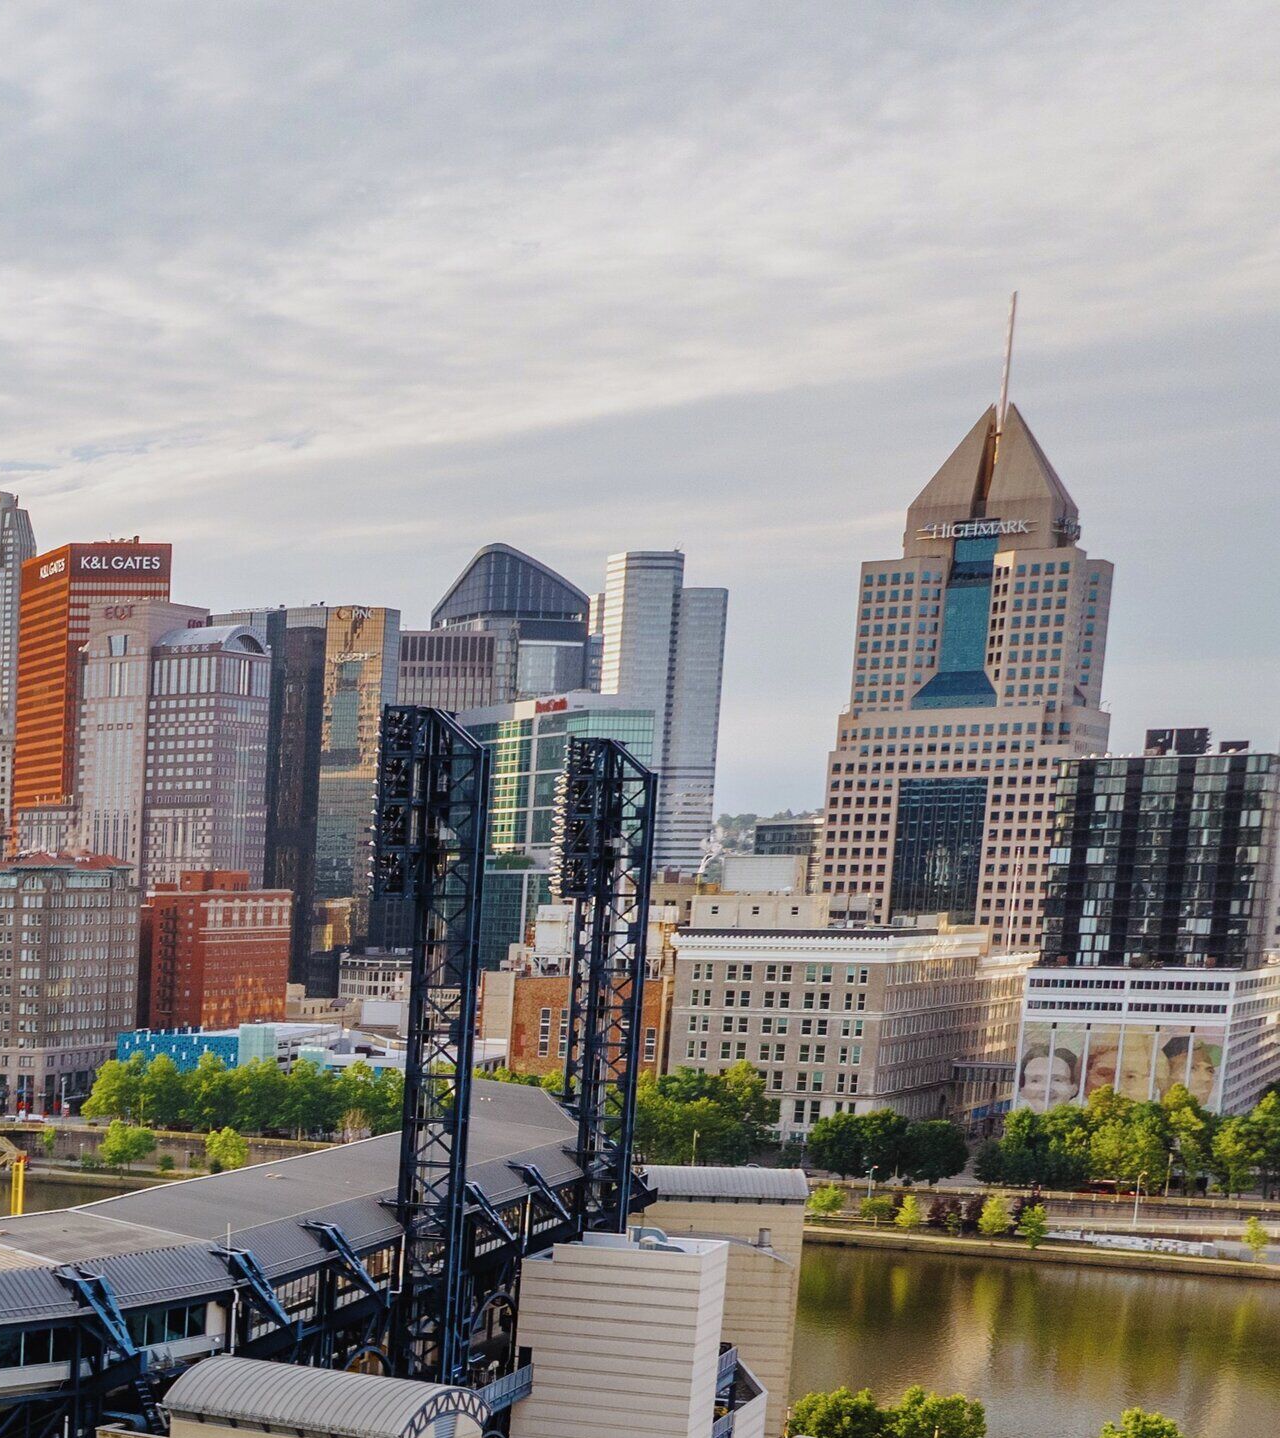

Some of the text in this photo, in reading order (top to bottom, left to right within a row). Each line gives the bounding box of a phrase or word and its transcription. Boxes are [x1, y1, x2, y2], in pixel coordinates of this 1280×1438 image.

[928, 519, 1030, 539] HIGHMARK
[50, 558, 66, 577] GATES
[80, 556, 161, 570] K&L GATES
[105, 604, 136, 621] EQT
[352, 609, 374, 620] PNC
